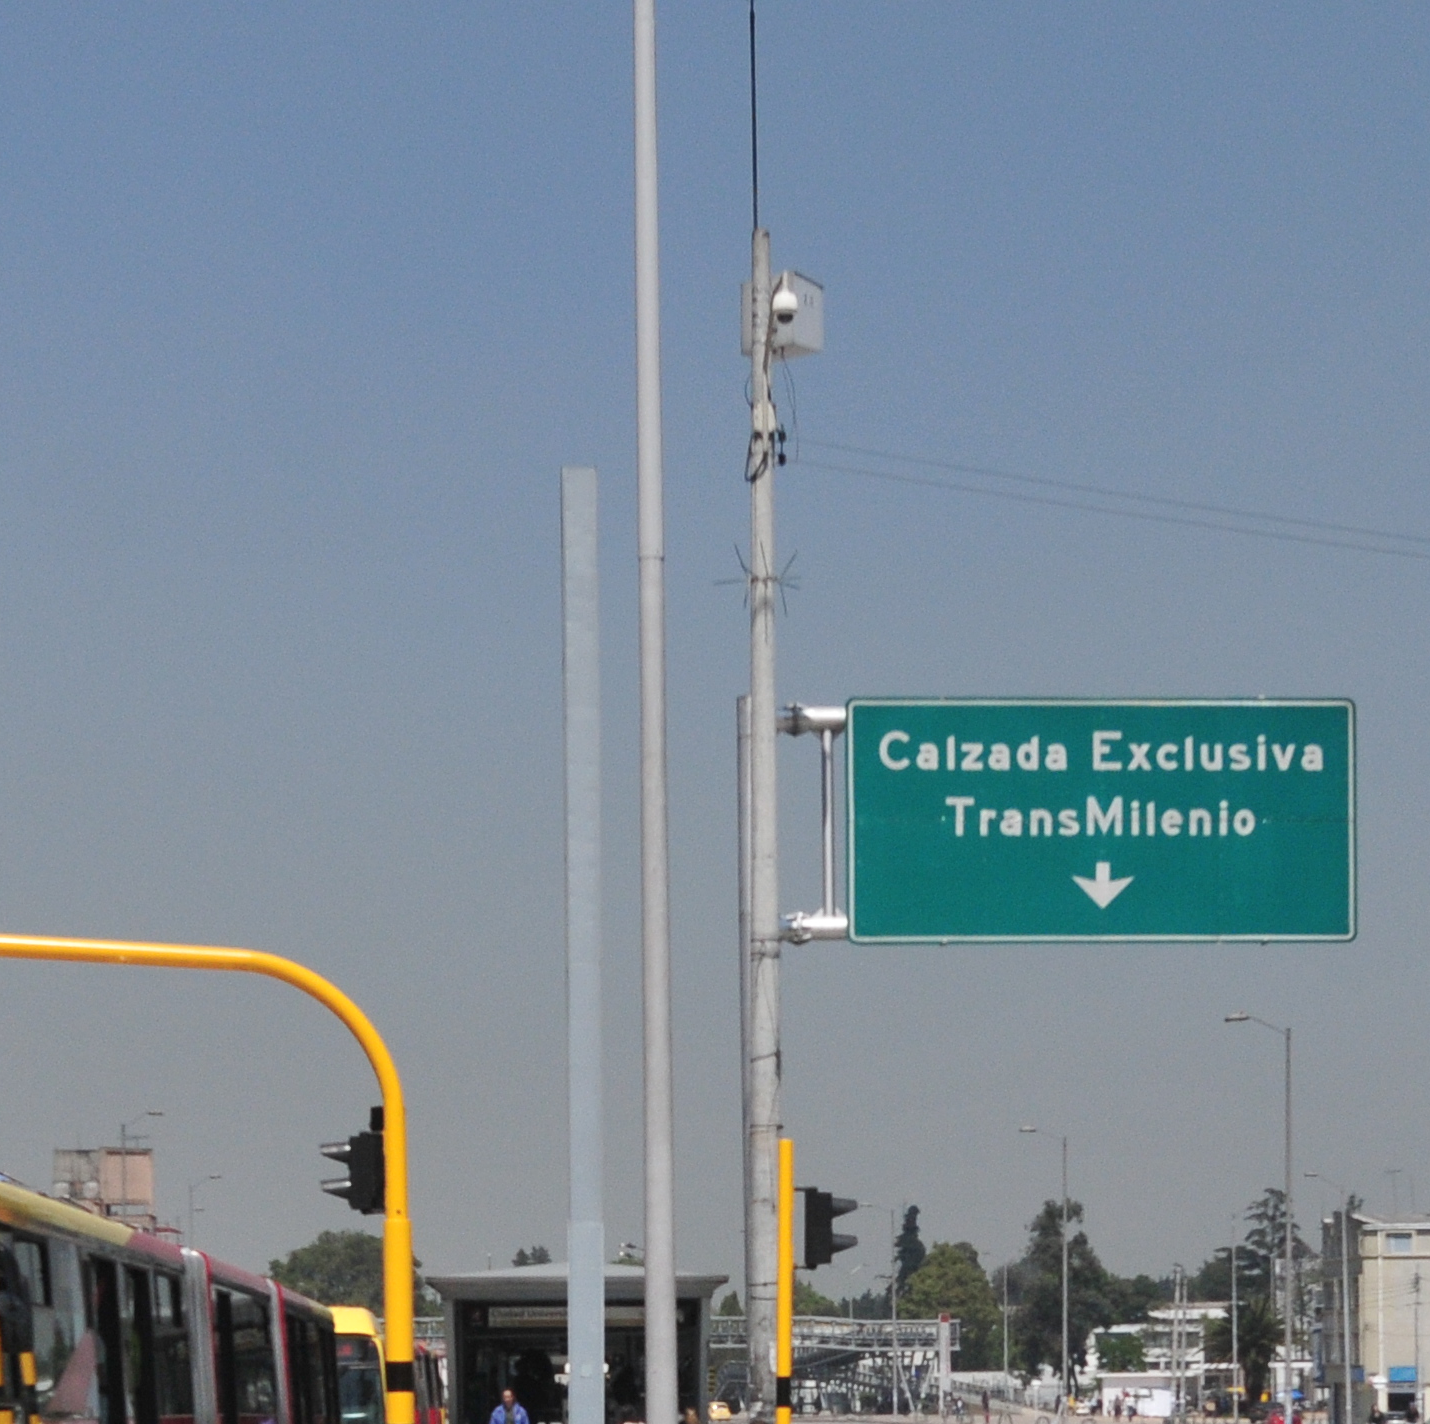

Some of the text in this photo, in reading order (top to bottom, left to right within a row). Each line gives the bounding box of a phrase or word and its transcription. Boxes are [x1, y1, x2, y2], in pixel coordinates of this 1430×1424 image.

[879, 731, 1324, 771] Calzada Exclusiva
[946, 796, 1256, 836] TransMilenio
